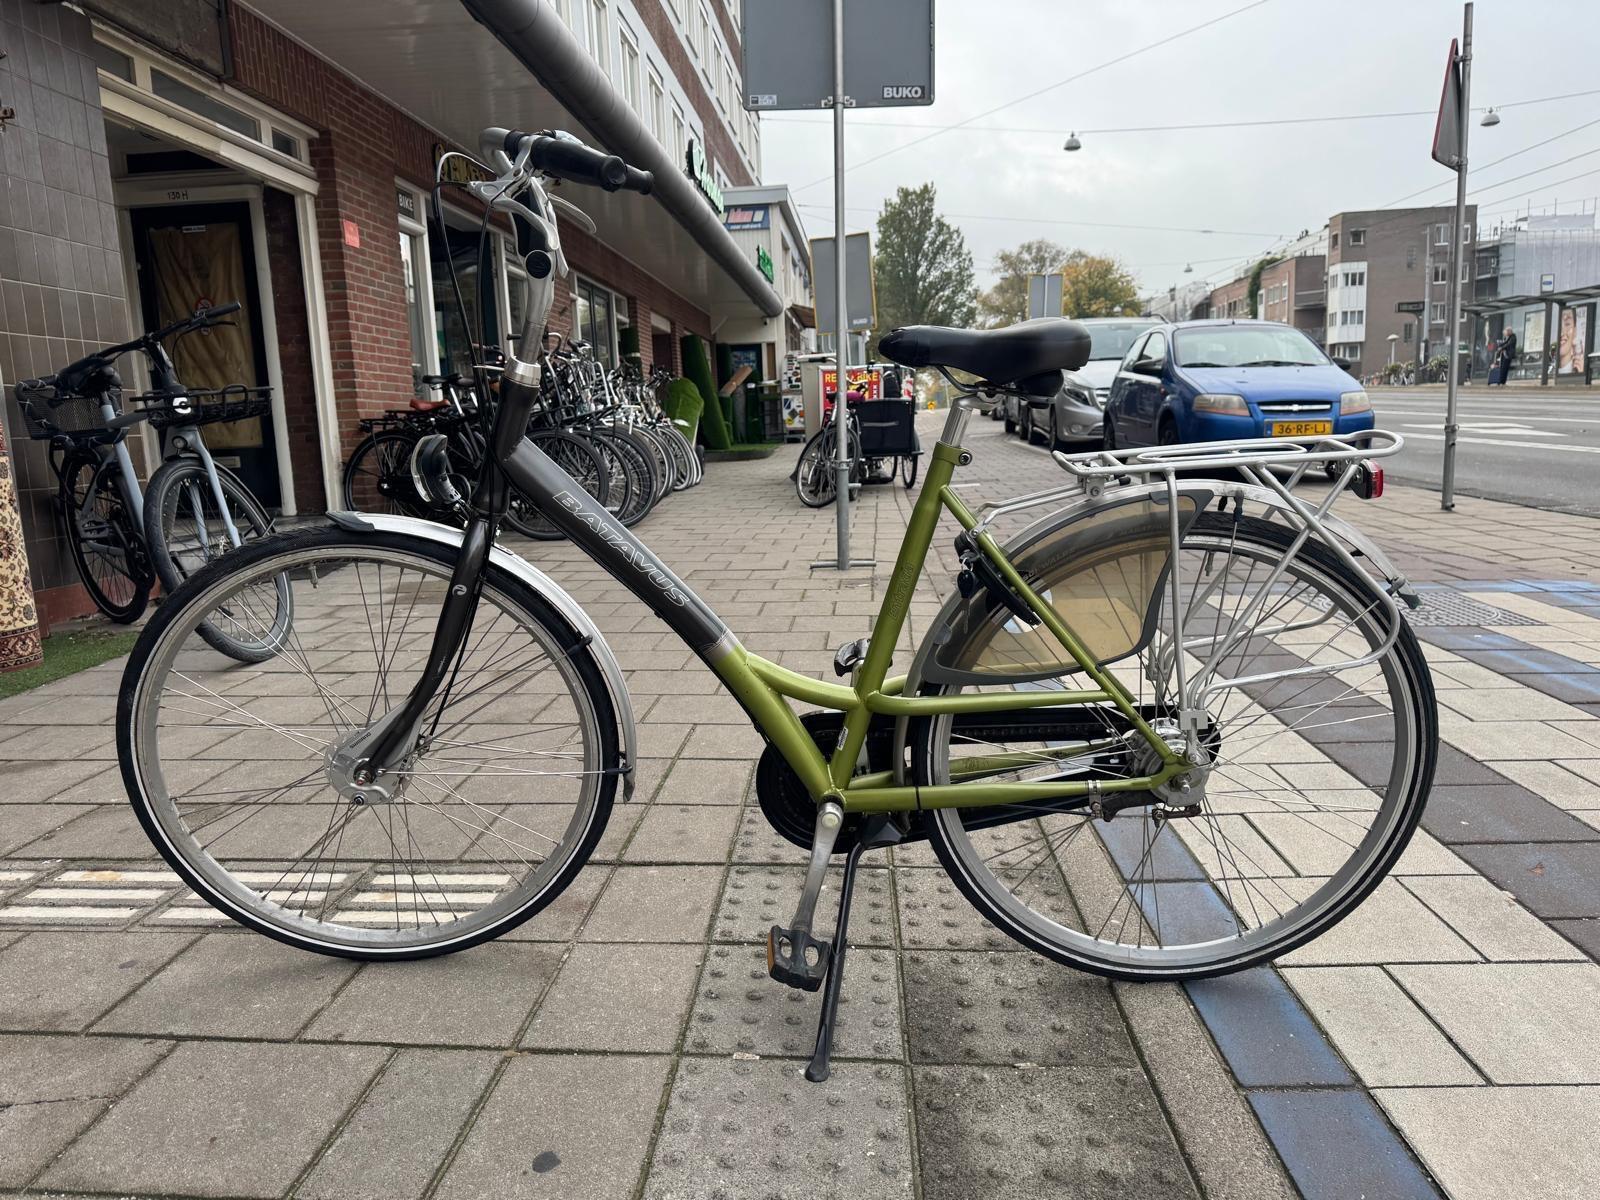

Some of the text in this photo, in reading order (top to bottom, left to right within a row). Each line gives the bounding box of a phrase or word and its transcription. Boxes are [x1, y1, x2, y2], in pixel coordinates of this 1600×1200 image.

[883, 86, 922, 98] BUKO
[398, 193, 413, 211] BIKE
[552, 490, 690, 607] BATAVUS
